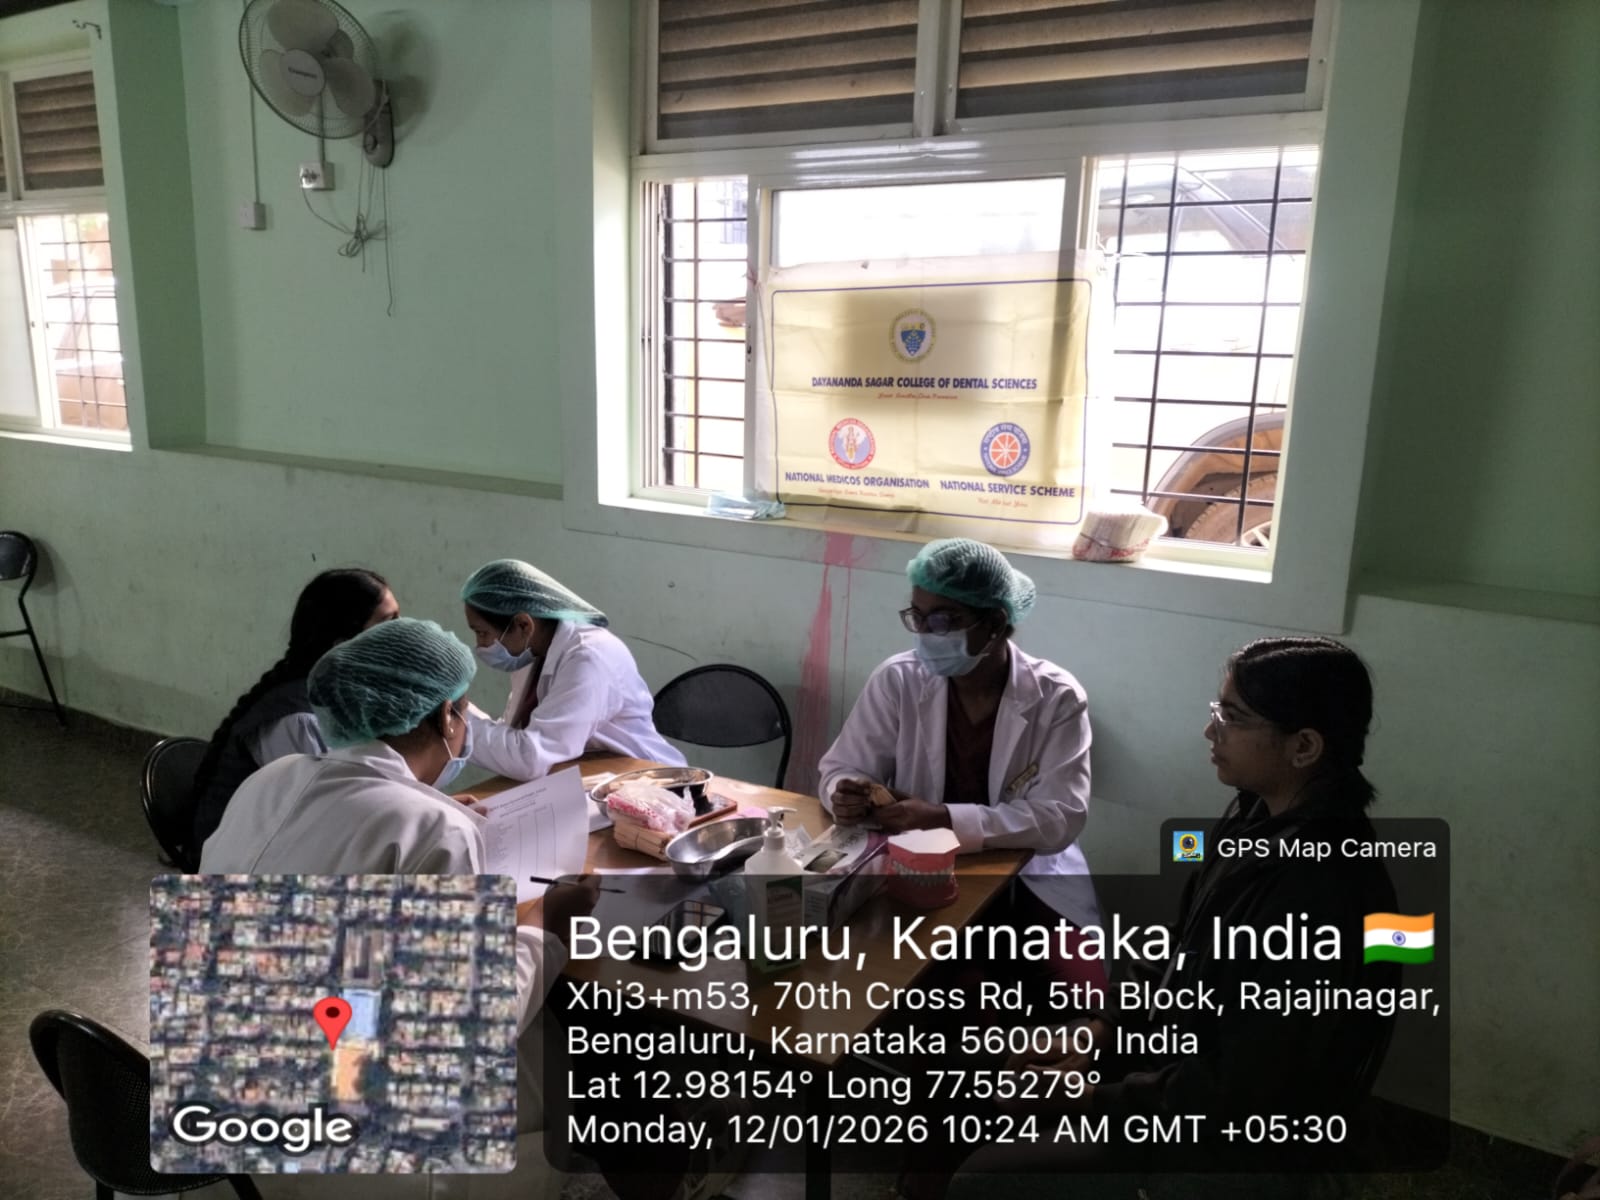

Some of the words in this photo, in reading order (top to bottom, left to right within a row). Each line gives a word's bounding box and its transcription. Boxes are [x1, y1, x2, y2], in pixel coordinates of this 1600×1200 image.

[811, 377, 863, 388] DAYANANDA
[864, 377, 894, 388] SAGAR
[896, 377, 936, 389] COLLEGE
[937, 378, 951, 389] OF
[952, 378, 989, 390] DENTAL
[991, 379, 1038, 390] SCIENCES
[785, 471, 825, 483] NATIONAL
[863, 476, 931, 489] ORGANISATION
[940, 480, 986, 493] NATIONAL
[987, 483, 1027, 496] SERVICE
[1029, 486, 1076, 498] SCHEME
